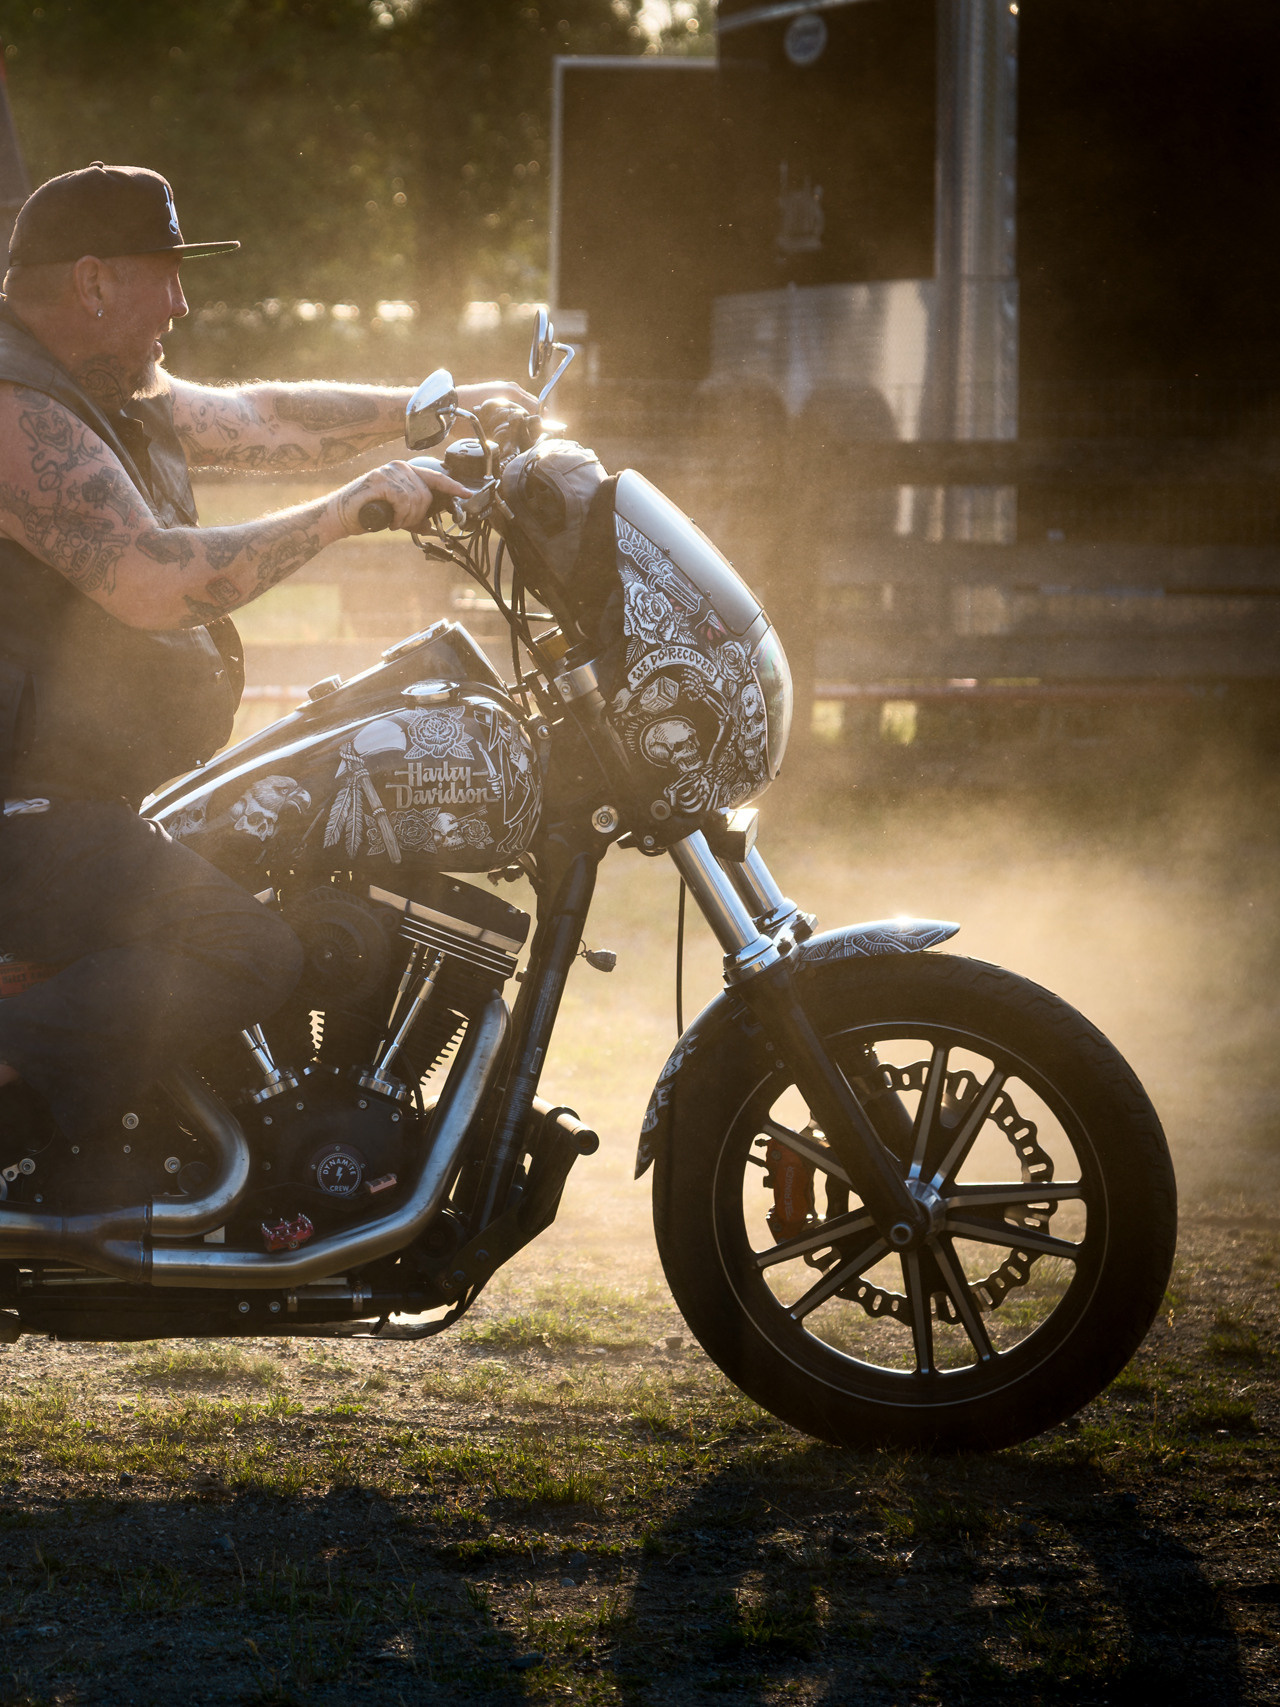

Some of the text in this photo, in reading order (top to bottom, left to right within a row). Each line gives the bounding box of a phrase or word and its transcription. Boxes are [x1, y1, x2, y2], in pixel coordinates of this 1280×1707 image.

[631, 647, 715, 681] WE DO RECOVER
[386, 783, 499, 808] Davidson
[323, 1158, 356, 1175] DYNAMITE
[784, 1166, 795, 1221] BERINGER
